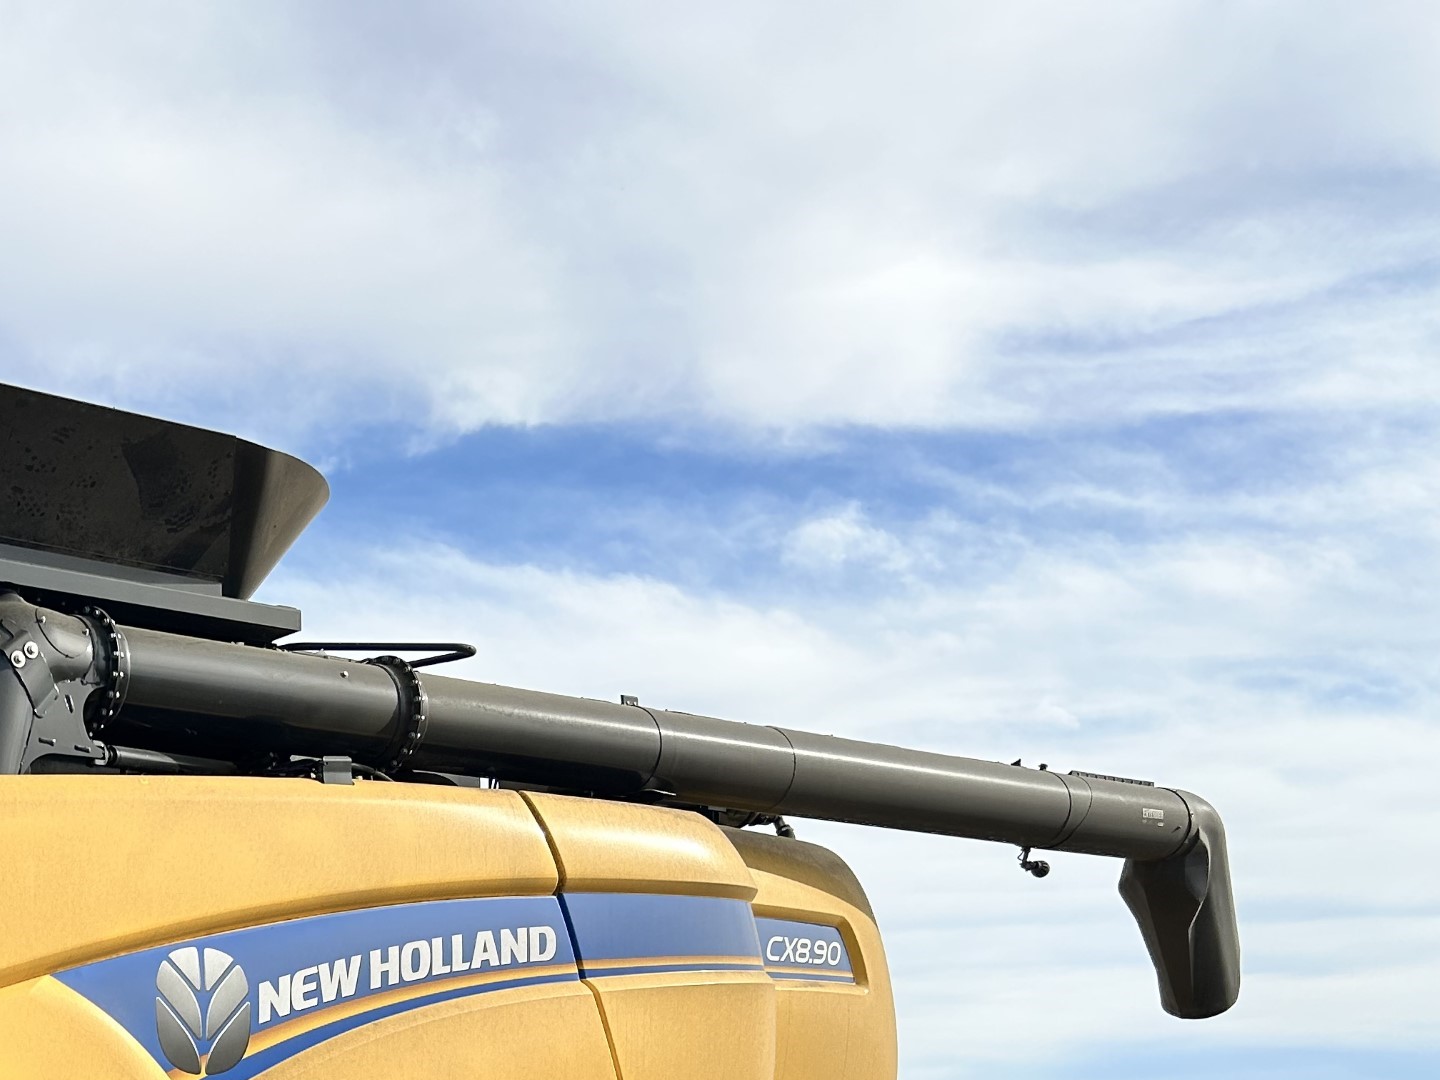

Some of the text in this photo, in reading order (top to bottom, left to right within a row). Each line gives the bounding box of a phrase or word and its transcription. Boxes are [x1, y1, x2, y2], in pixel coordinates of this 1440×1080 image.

[258, 925, 557, 1025] NEW HOLLAND
[766, 935, 842, 966] CX8.90
